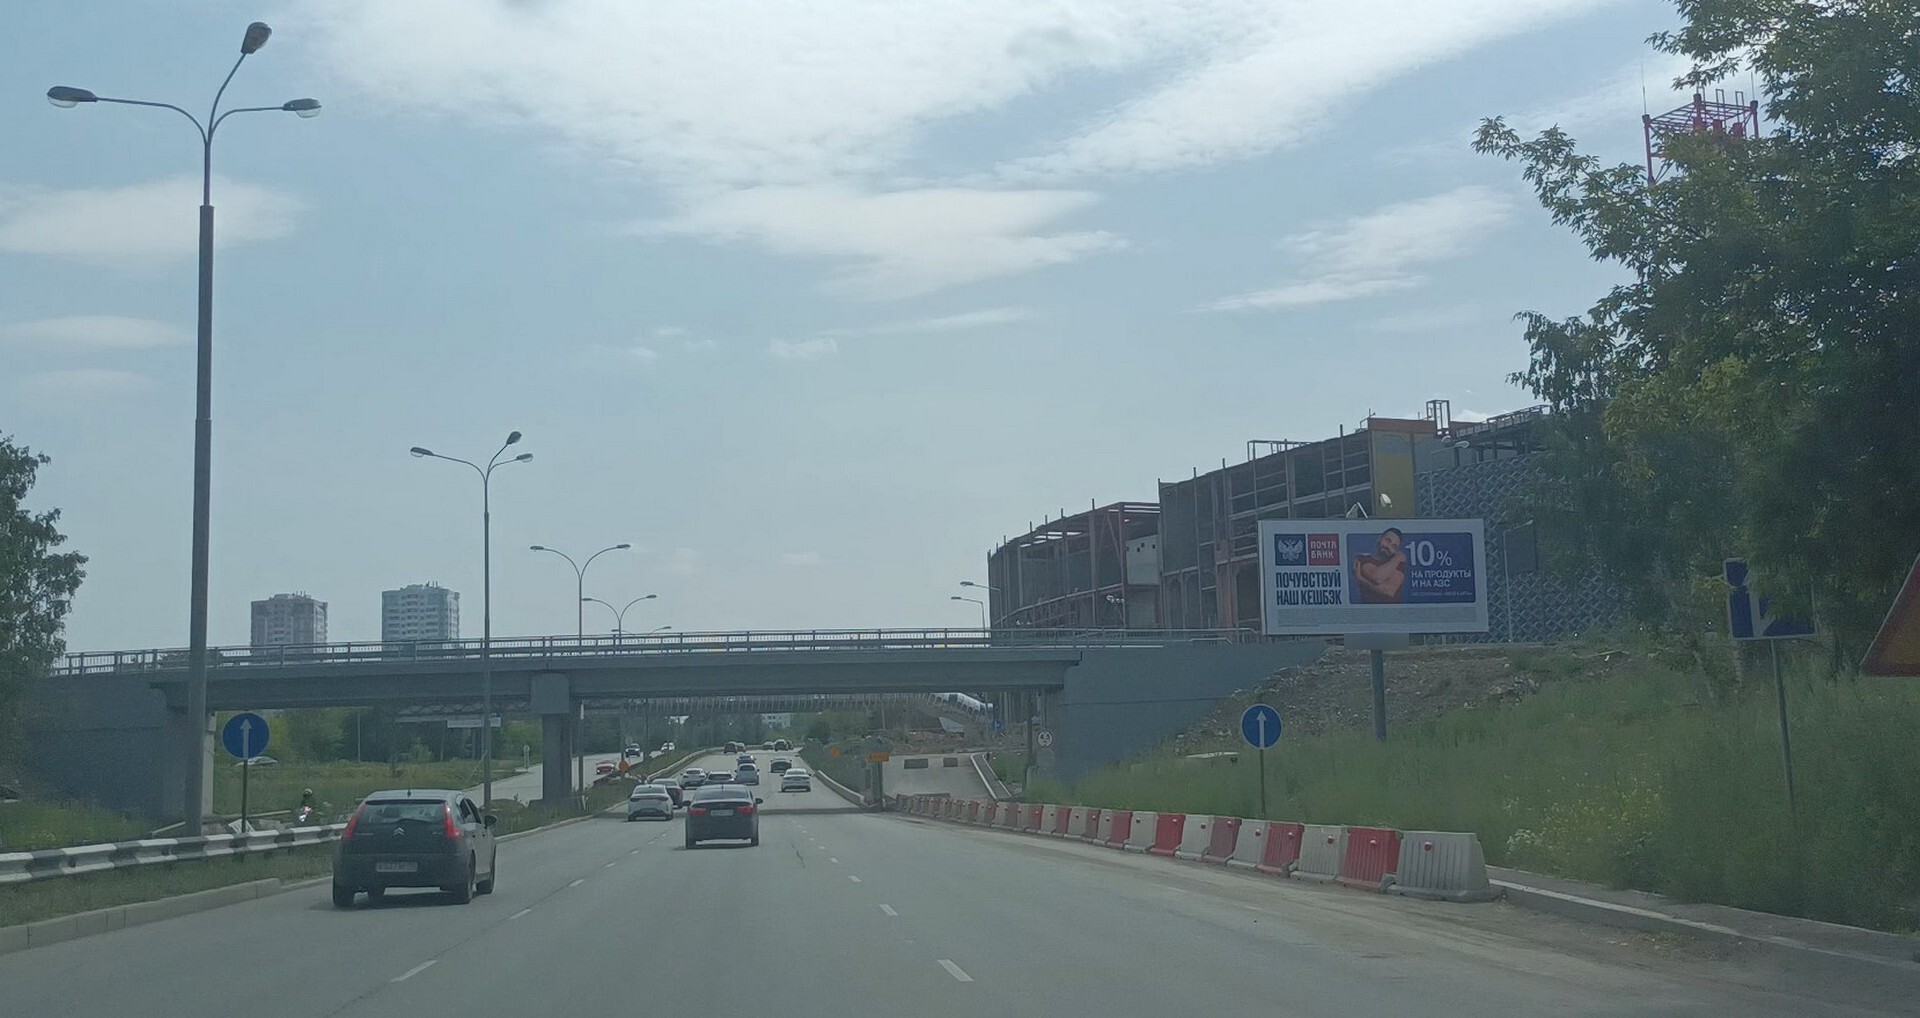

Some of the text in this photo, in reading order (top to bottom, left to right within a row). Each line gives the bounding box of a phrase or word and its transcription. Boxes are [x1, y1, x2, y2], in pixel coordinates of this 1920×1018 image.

[1310, 541, 1337, 549] ПОЧТА
[1310, 550, 1334, 559] БАНК
[1405, 540, 1452, 567] 10%
[1276, 569, 1341, 588] ПОЧУВСТВУЙ
[1411, 570, 1472, 579] НА ПРОДУКТЫ
[1411, 579, 1451, 588] И НА АЗС
[1277, 589, 1342, 606] НАШ КЕШБЭК
